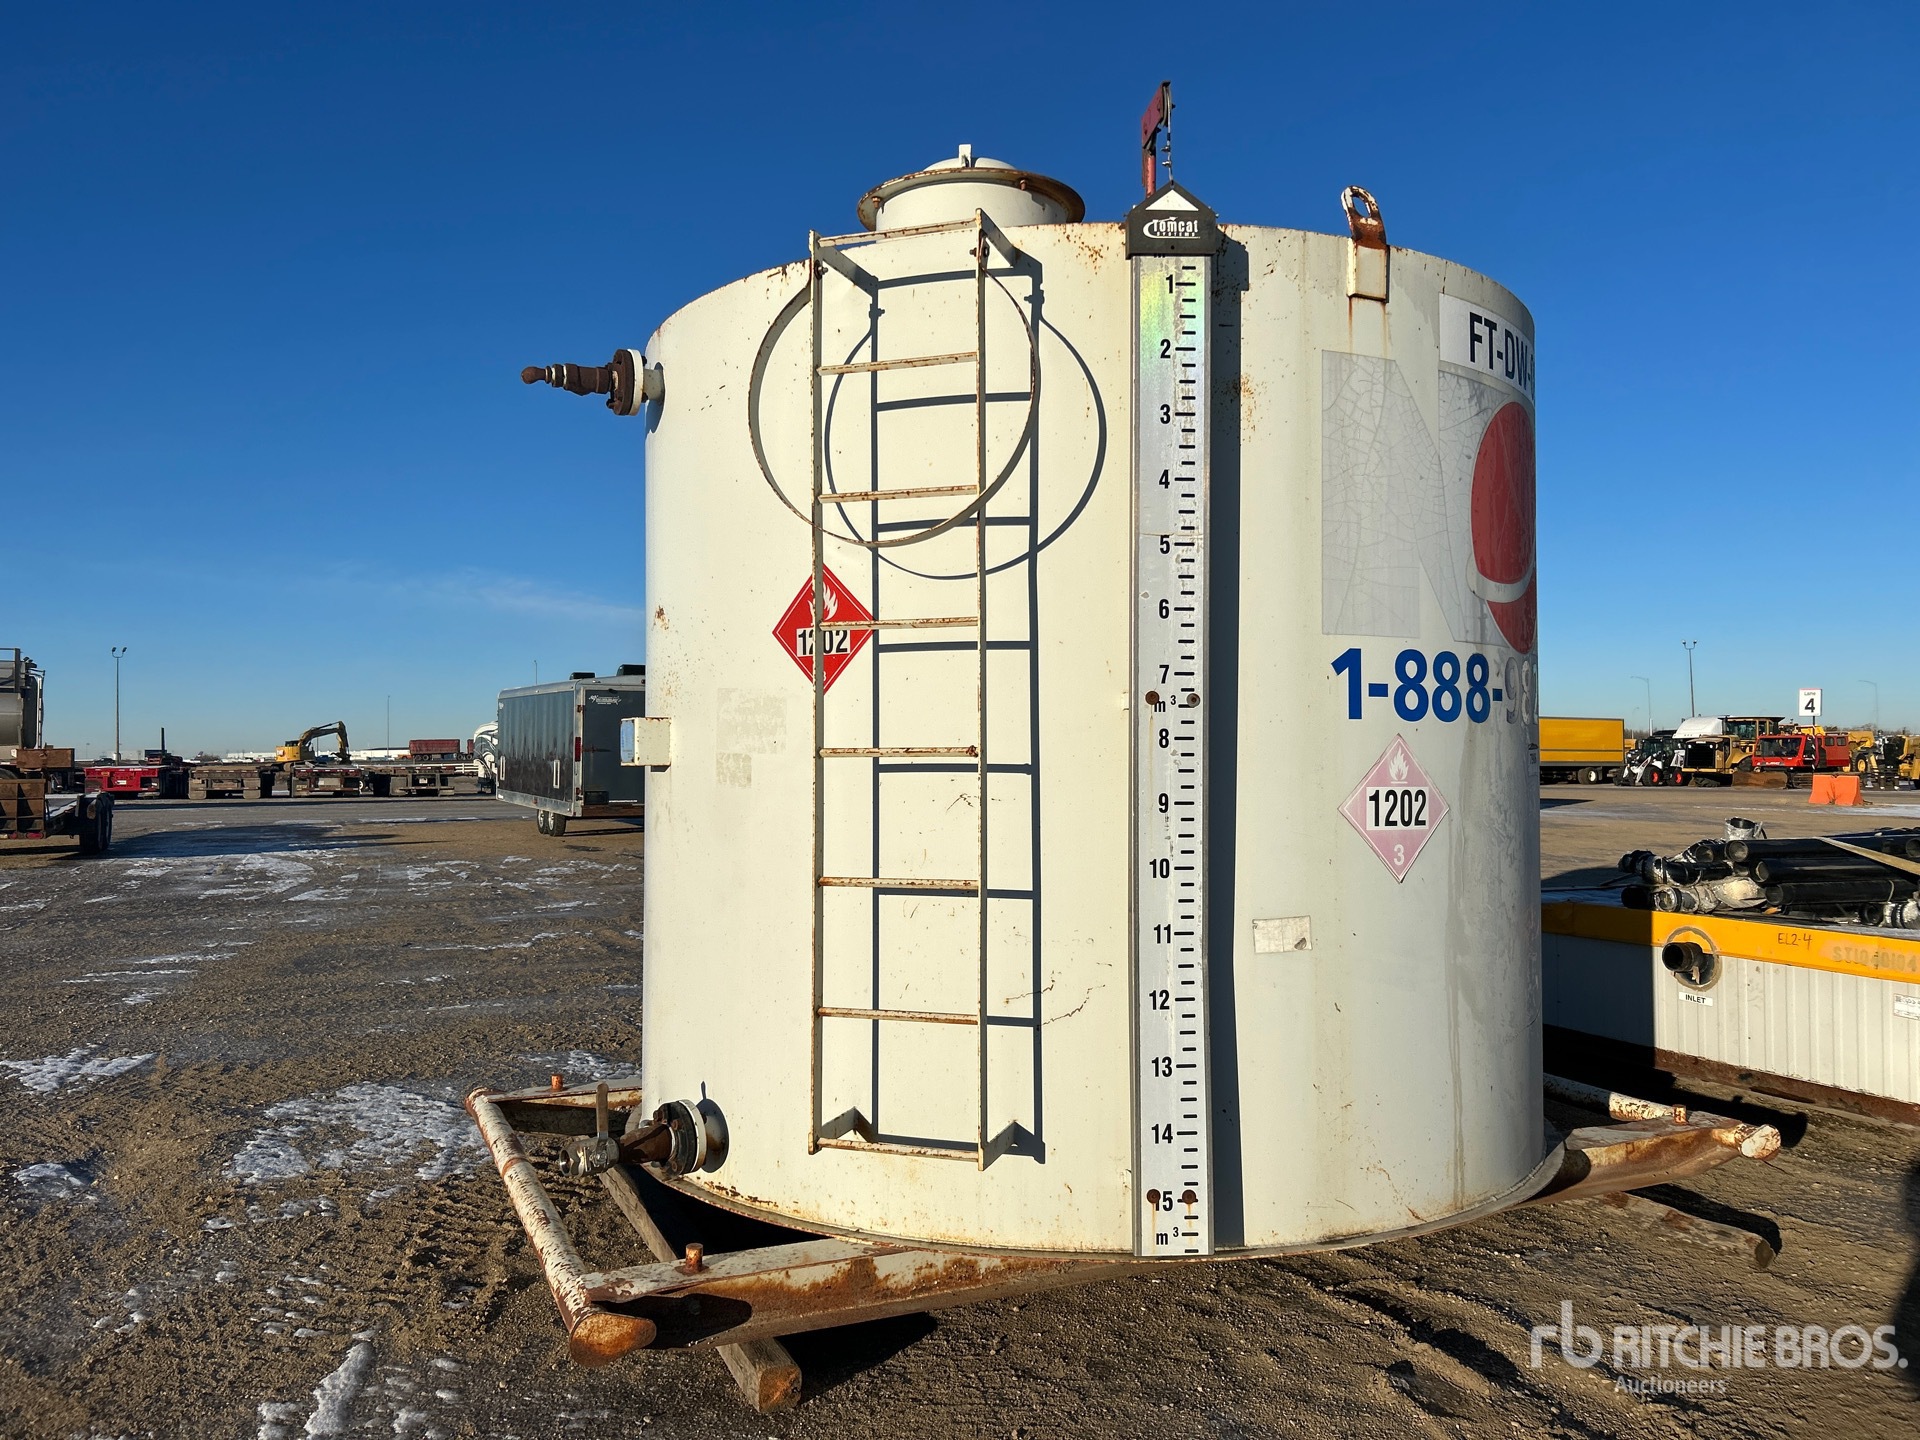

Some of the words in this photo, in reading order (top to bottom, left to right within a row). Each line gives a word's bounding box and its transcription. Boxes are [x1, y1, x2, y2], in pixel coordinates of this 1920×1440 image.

[1152, 219, 1199, 233] Tomcat
[1165, 274, 1174, 294] 1
[1160, 338, 1171, 359] 2
[1159, 403, 1171, 425] 3
[1158, 469, 1170, 489] 4
[1159, 534, 1171, 555] 5
[1158, 598, 1170, 620] 6
[1159, 664, 1170, 684] 7
[1804, 698, 1816, 713] 4
[1158, 728, 1170, 749] 8
[1158, 792, 1169, 814] 9
[1368, 789, 1427, 827] 1202
[1393, 844, 1405, 866] 3
[1149, 858, 1170, 879] 10
[1153, 923, 1171, 944] 11
[1149, 989, 1170, 1011] 12
[1685, 994, 1706, 1004] INLET
[1151, 1056, 1173, 1078] 13
[1151, 1123, 1174, 1144] 14
